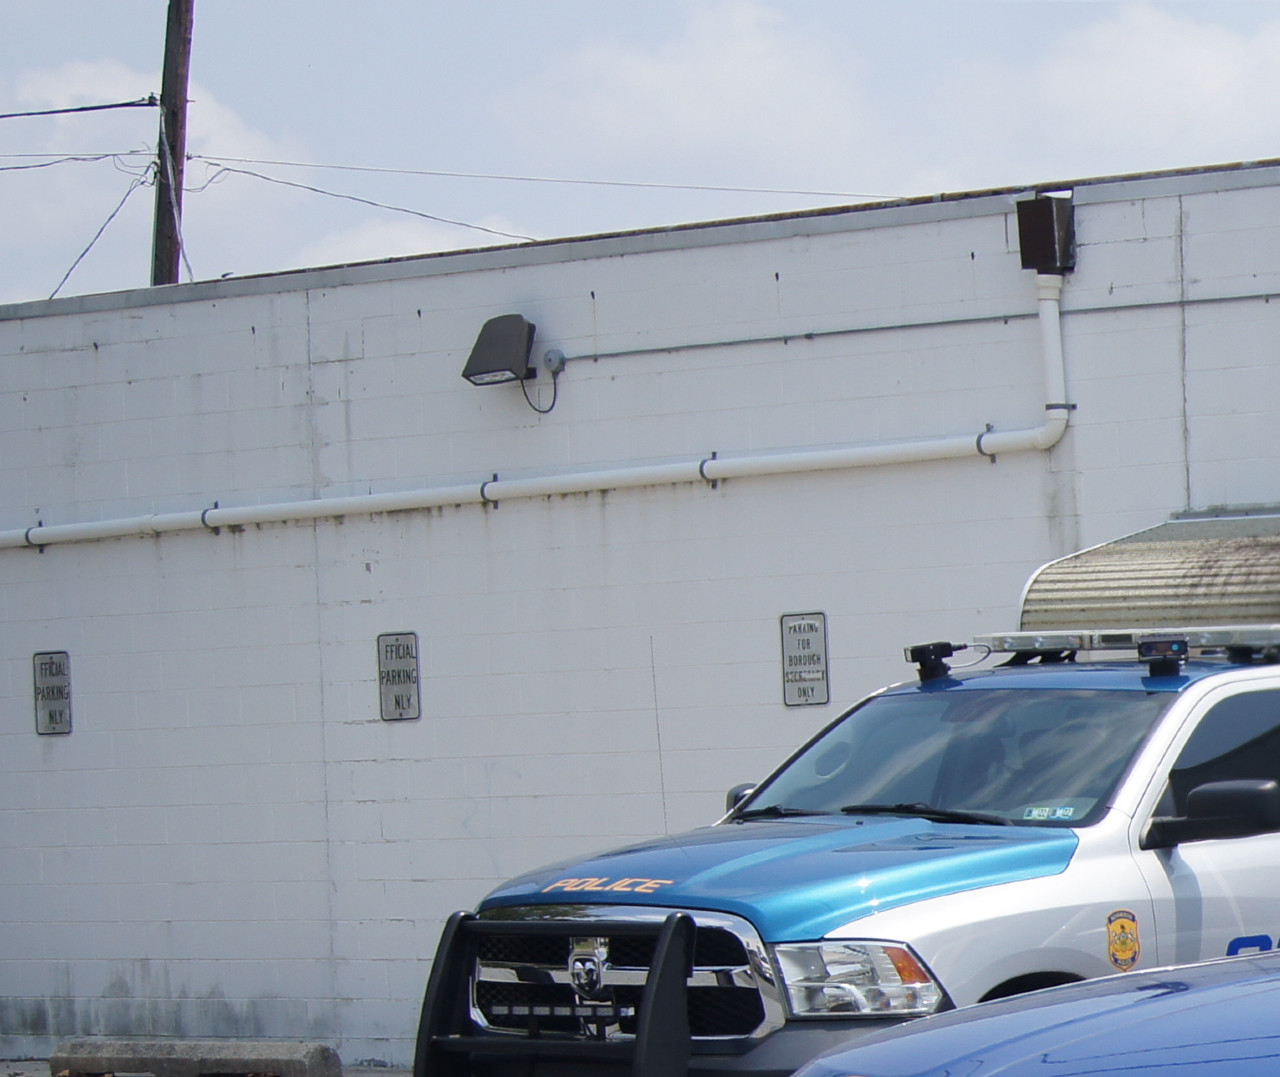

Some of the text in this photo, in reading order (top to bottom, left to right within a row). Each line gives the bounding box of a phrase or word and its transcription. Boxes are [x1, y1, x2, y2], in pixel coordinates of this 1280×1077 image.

[788, 622, 820, 635] PARKING
[797, 638, 811, 650] FOR
[788, 653, 821, 667] BOROUGH
[381, 668, 417, 686] PARKING
[37, 684, 69, 701] PARKING
[797, 686, 815, 698] ONLY
[541, 877, 675, 893] POLICE
